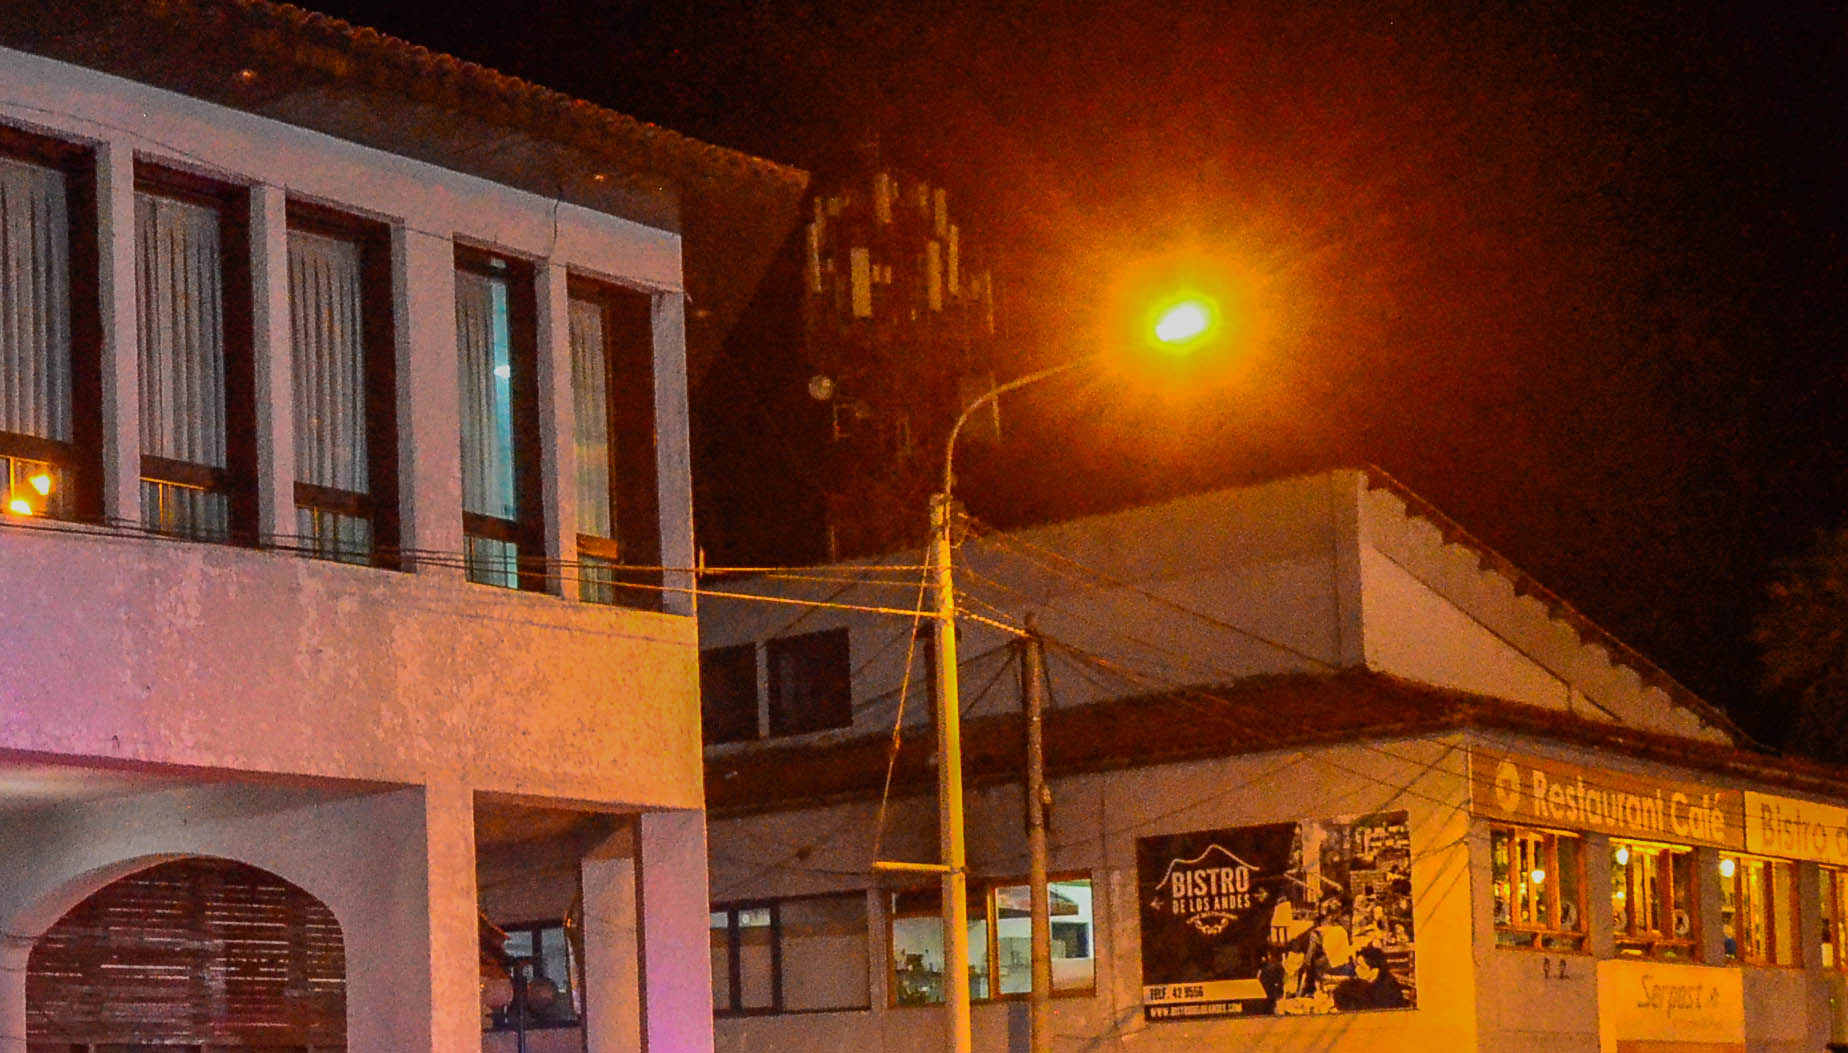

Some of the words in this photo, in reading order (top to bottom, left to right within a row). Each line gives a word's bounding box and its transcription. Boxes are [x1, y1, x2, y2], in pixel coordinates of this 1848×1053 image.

[1532, 769, 1664, 833] Restaurant
[1171, 865, 1250, 898] BISTRO
[1172, 898, 1186, 914] DE
[1189, 896, 1210, 912] LOS
[1213, 893, 1251, 910] ANDES
